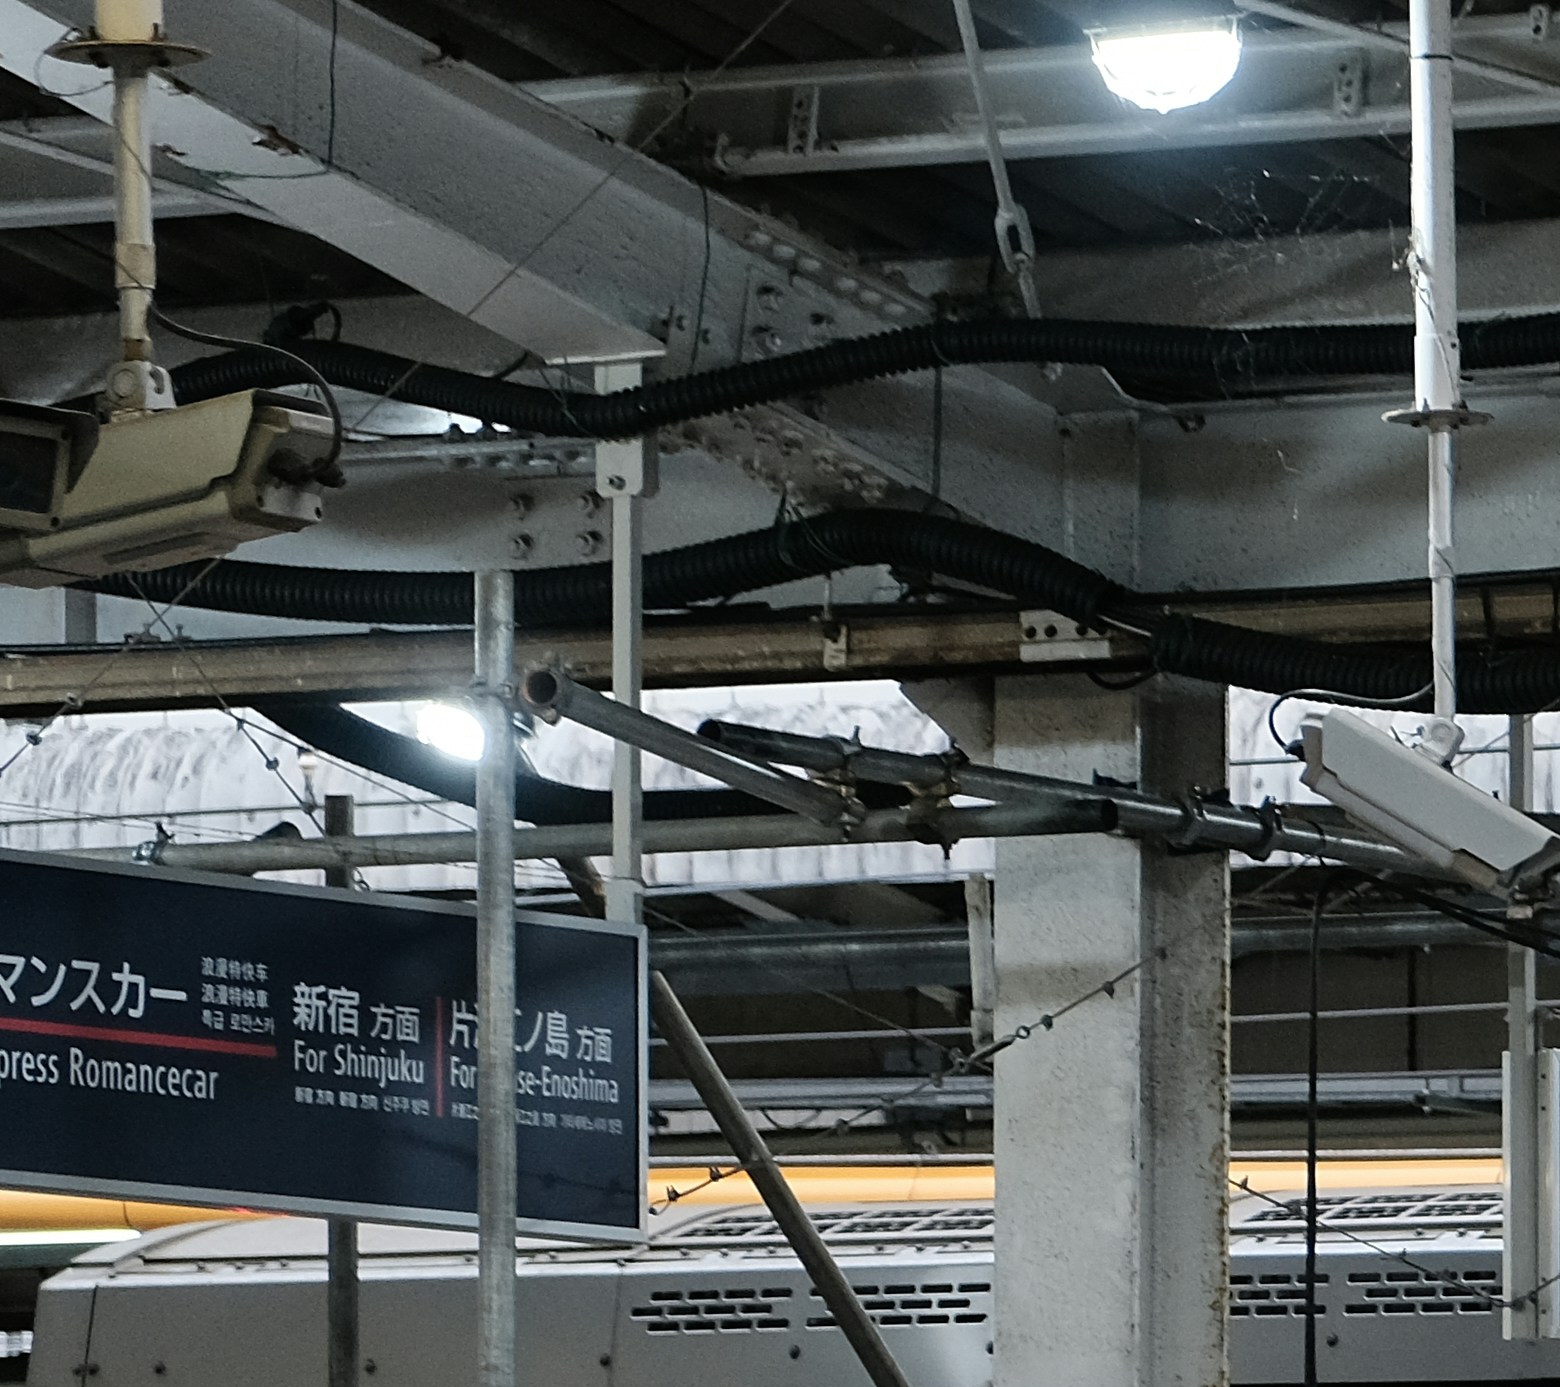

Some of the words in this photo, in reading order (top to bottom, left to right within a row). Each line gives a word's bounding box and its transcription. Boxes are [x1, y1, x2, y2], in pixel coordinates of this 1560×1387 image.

[292, 981, 360, 1036] 新宿
[370, 1003, 420, 1043] 方面
[294, 1039, 328, 1074] For
[334, 1043, 425, 1088] Shinjuku
[576, 1026, 612, 1063] 方面
[69, 1047, 219, 1099] Romancecar
[450, 1056, 478, 1089] For
